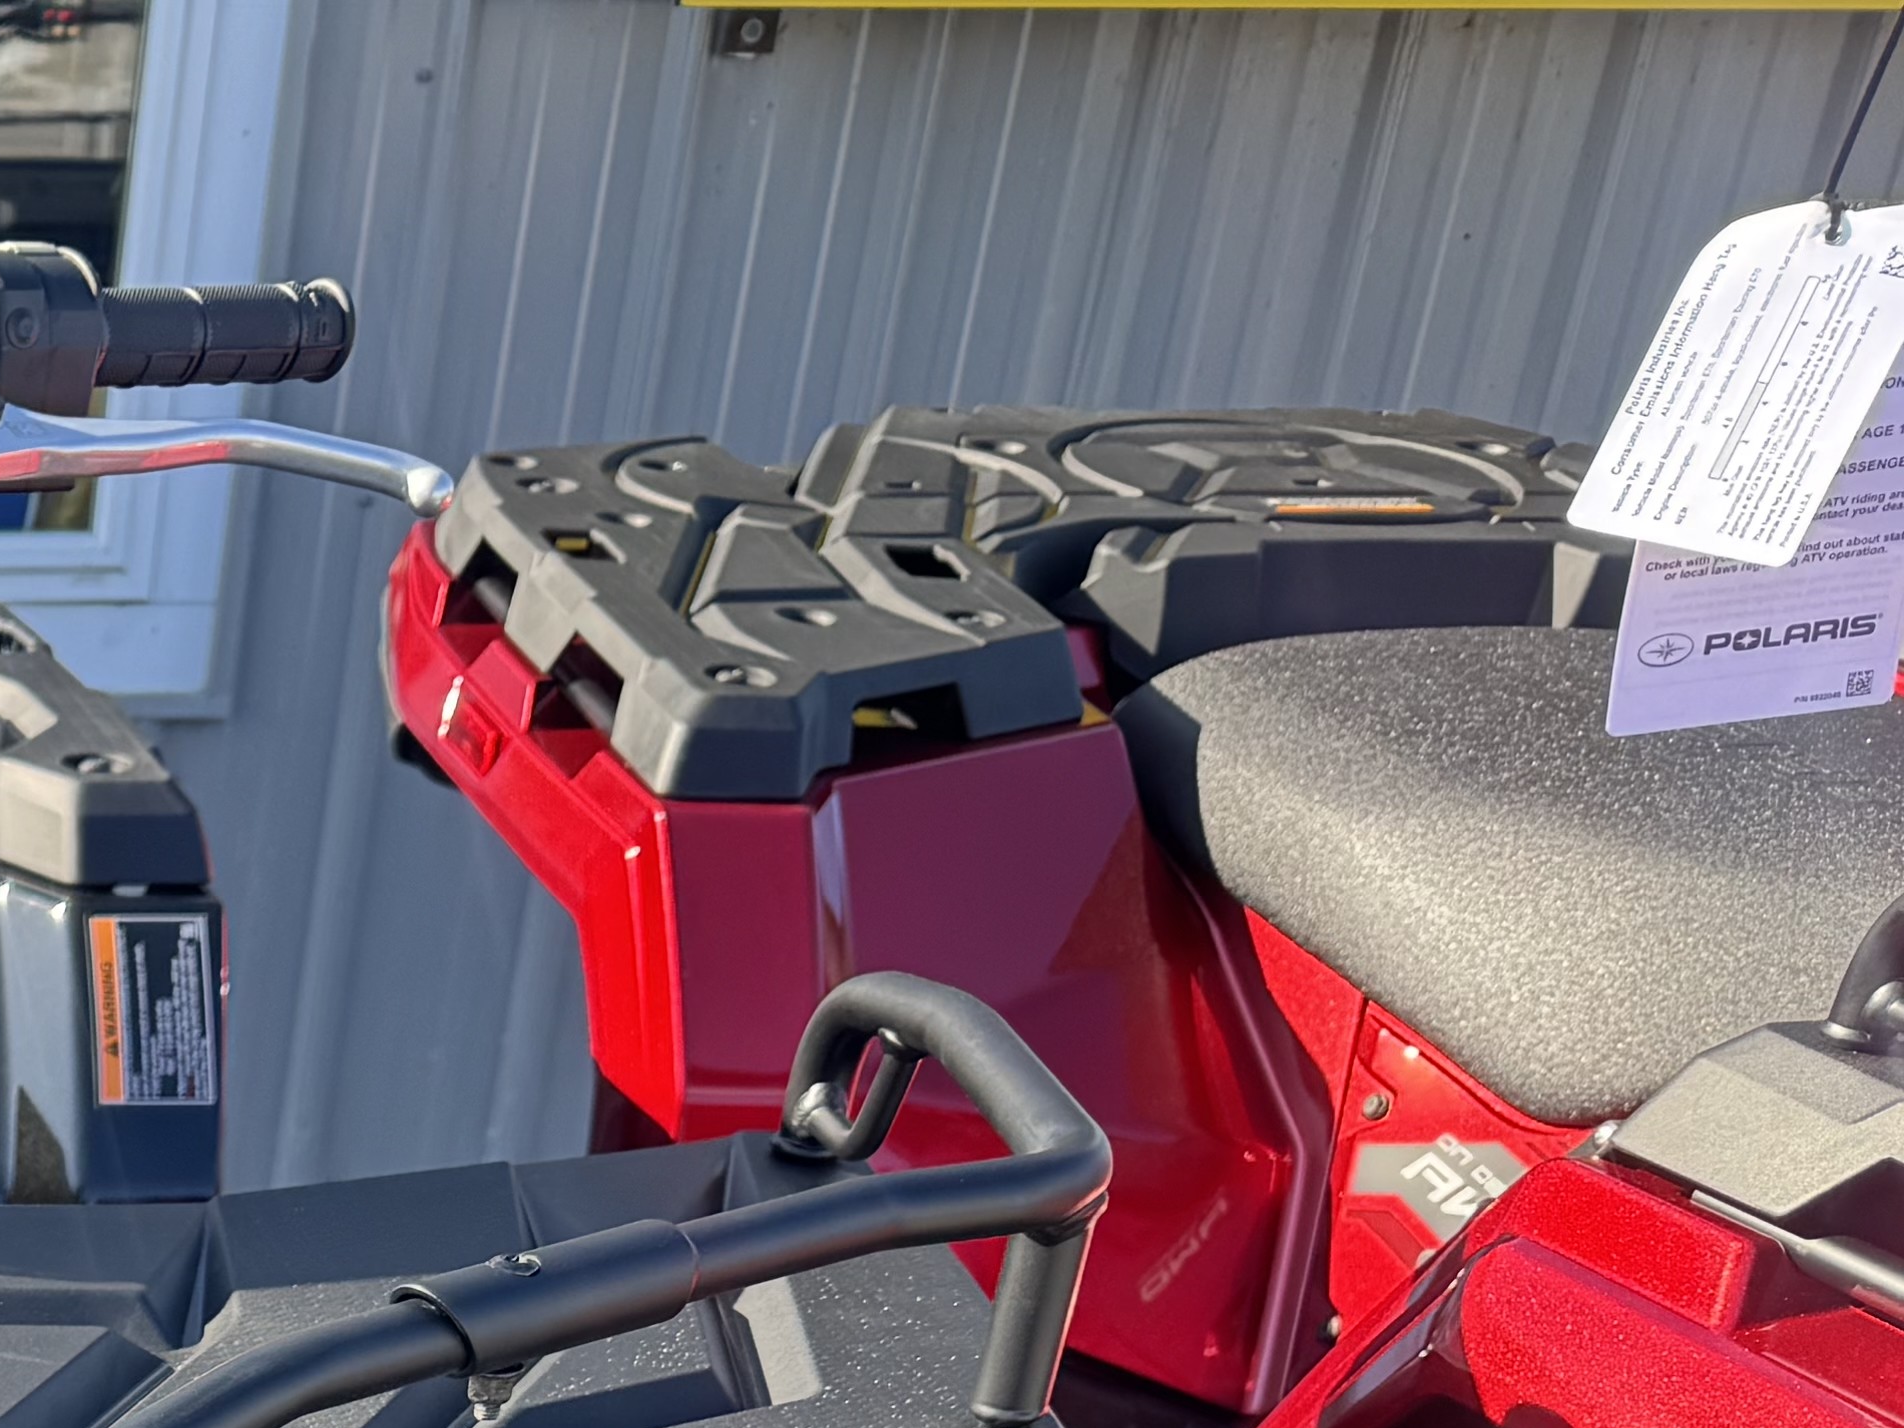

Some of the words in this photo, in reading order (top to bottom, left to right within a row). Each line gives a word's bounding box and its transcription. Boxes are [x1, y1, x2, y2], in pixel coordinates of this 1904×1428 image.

[1837, 456, 1904, 475] ASSENGE
[1823, 496, 1849, 508] ATV
[1851, 493, 1886, 505] riding
[1824, 539, 1844, 550] out
[1847, 534, 1881, 547] about
[1645, 559, 1683, 572] Check
[1801, 552, 1827, 564] ATV
